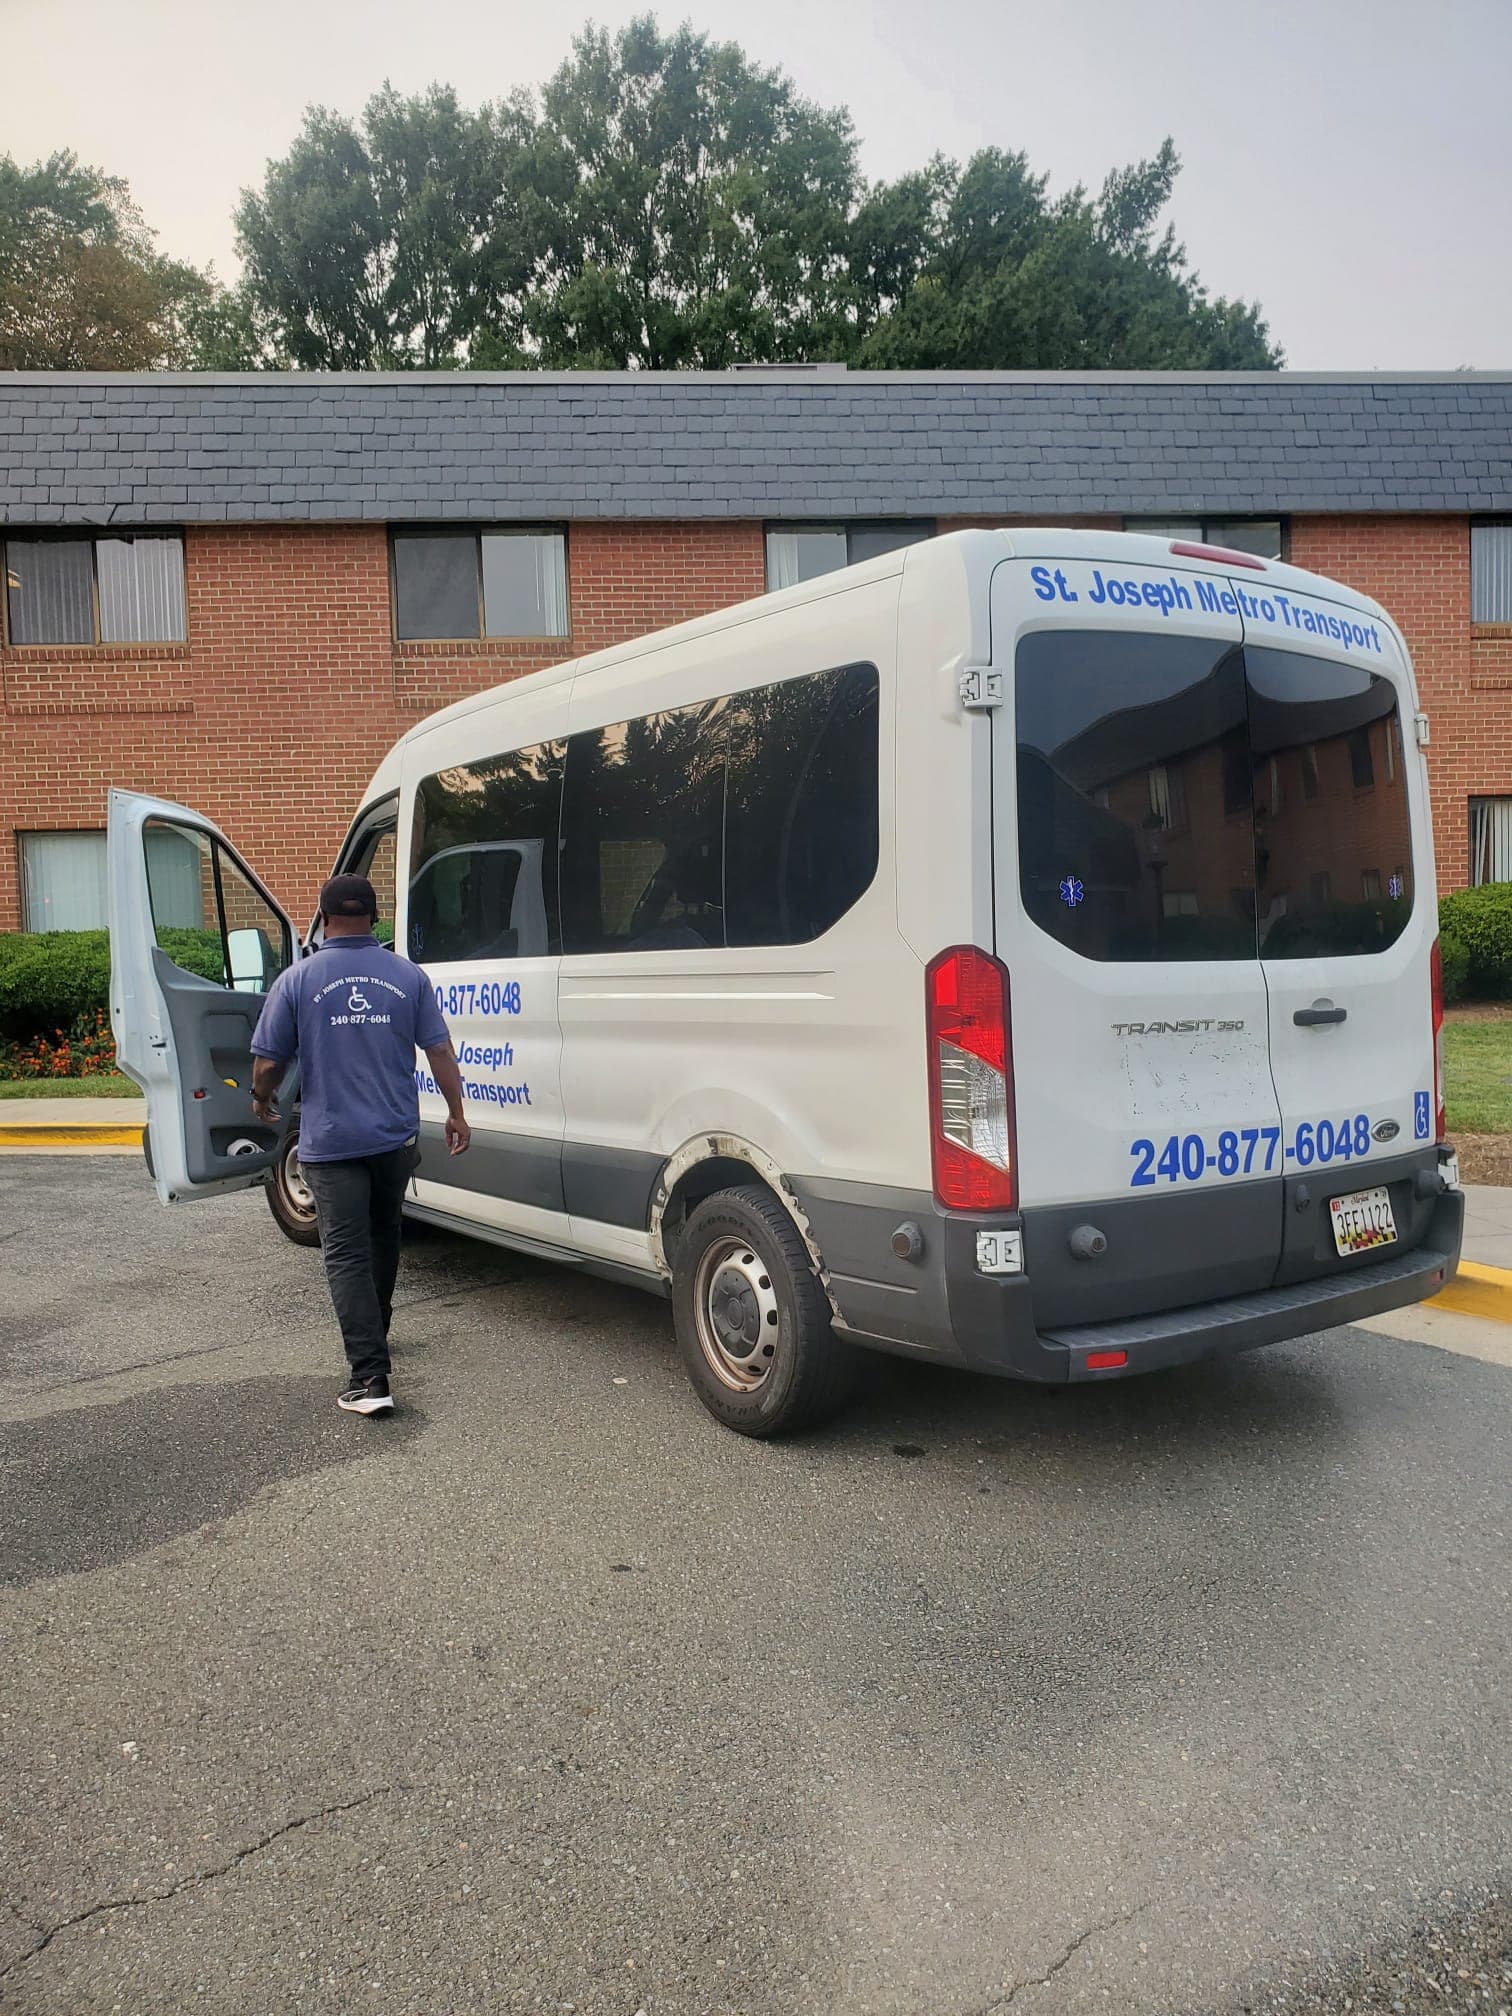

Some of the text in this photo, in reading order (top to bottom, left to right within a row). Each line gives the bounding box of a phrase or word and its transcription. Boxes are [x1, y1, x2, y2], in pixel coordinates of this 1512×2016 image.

[1030, 566, 1382, 653] St. Joseph Metro Transport
[322, 978, 345, 995] JOSEPH
[345, 976, 369, 984] METRO
[370, 977, 407, 1000] TRANSPORT
[435, 981, 521, 1015] 0-877-6048
[330, 1014, 348, 1026] 240
[1110, 1018, 1245, 1036] TRANSIT 350
[456, 1041, 513, 1072] Joseph
[415, 1070, 532, 1108] Met Transport
[1130, 1114, 1370, 1187] 240-877-6048
